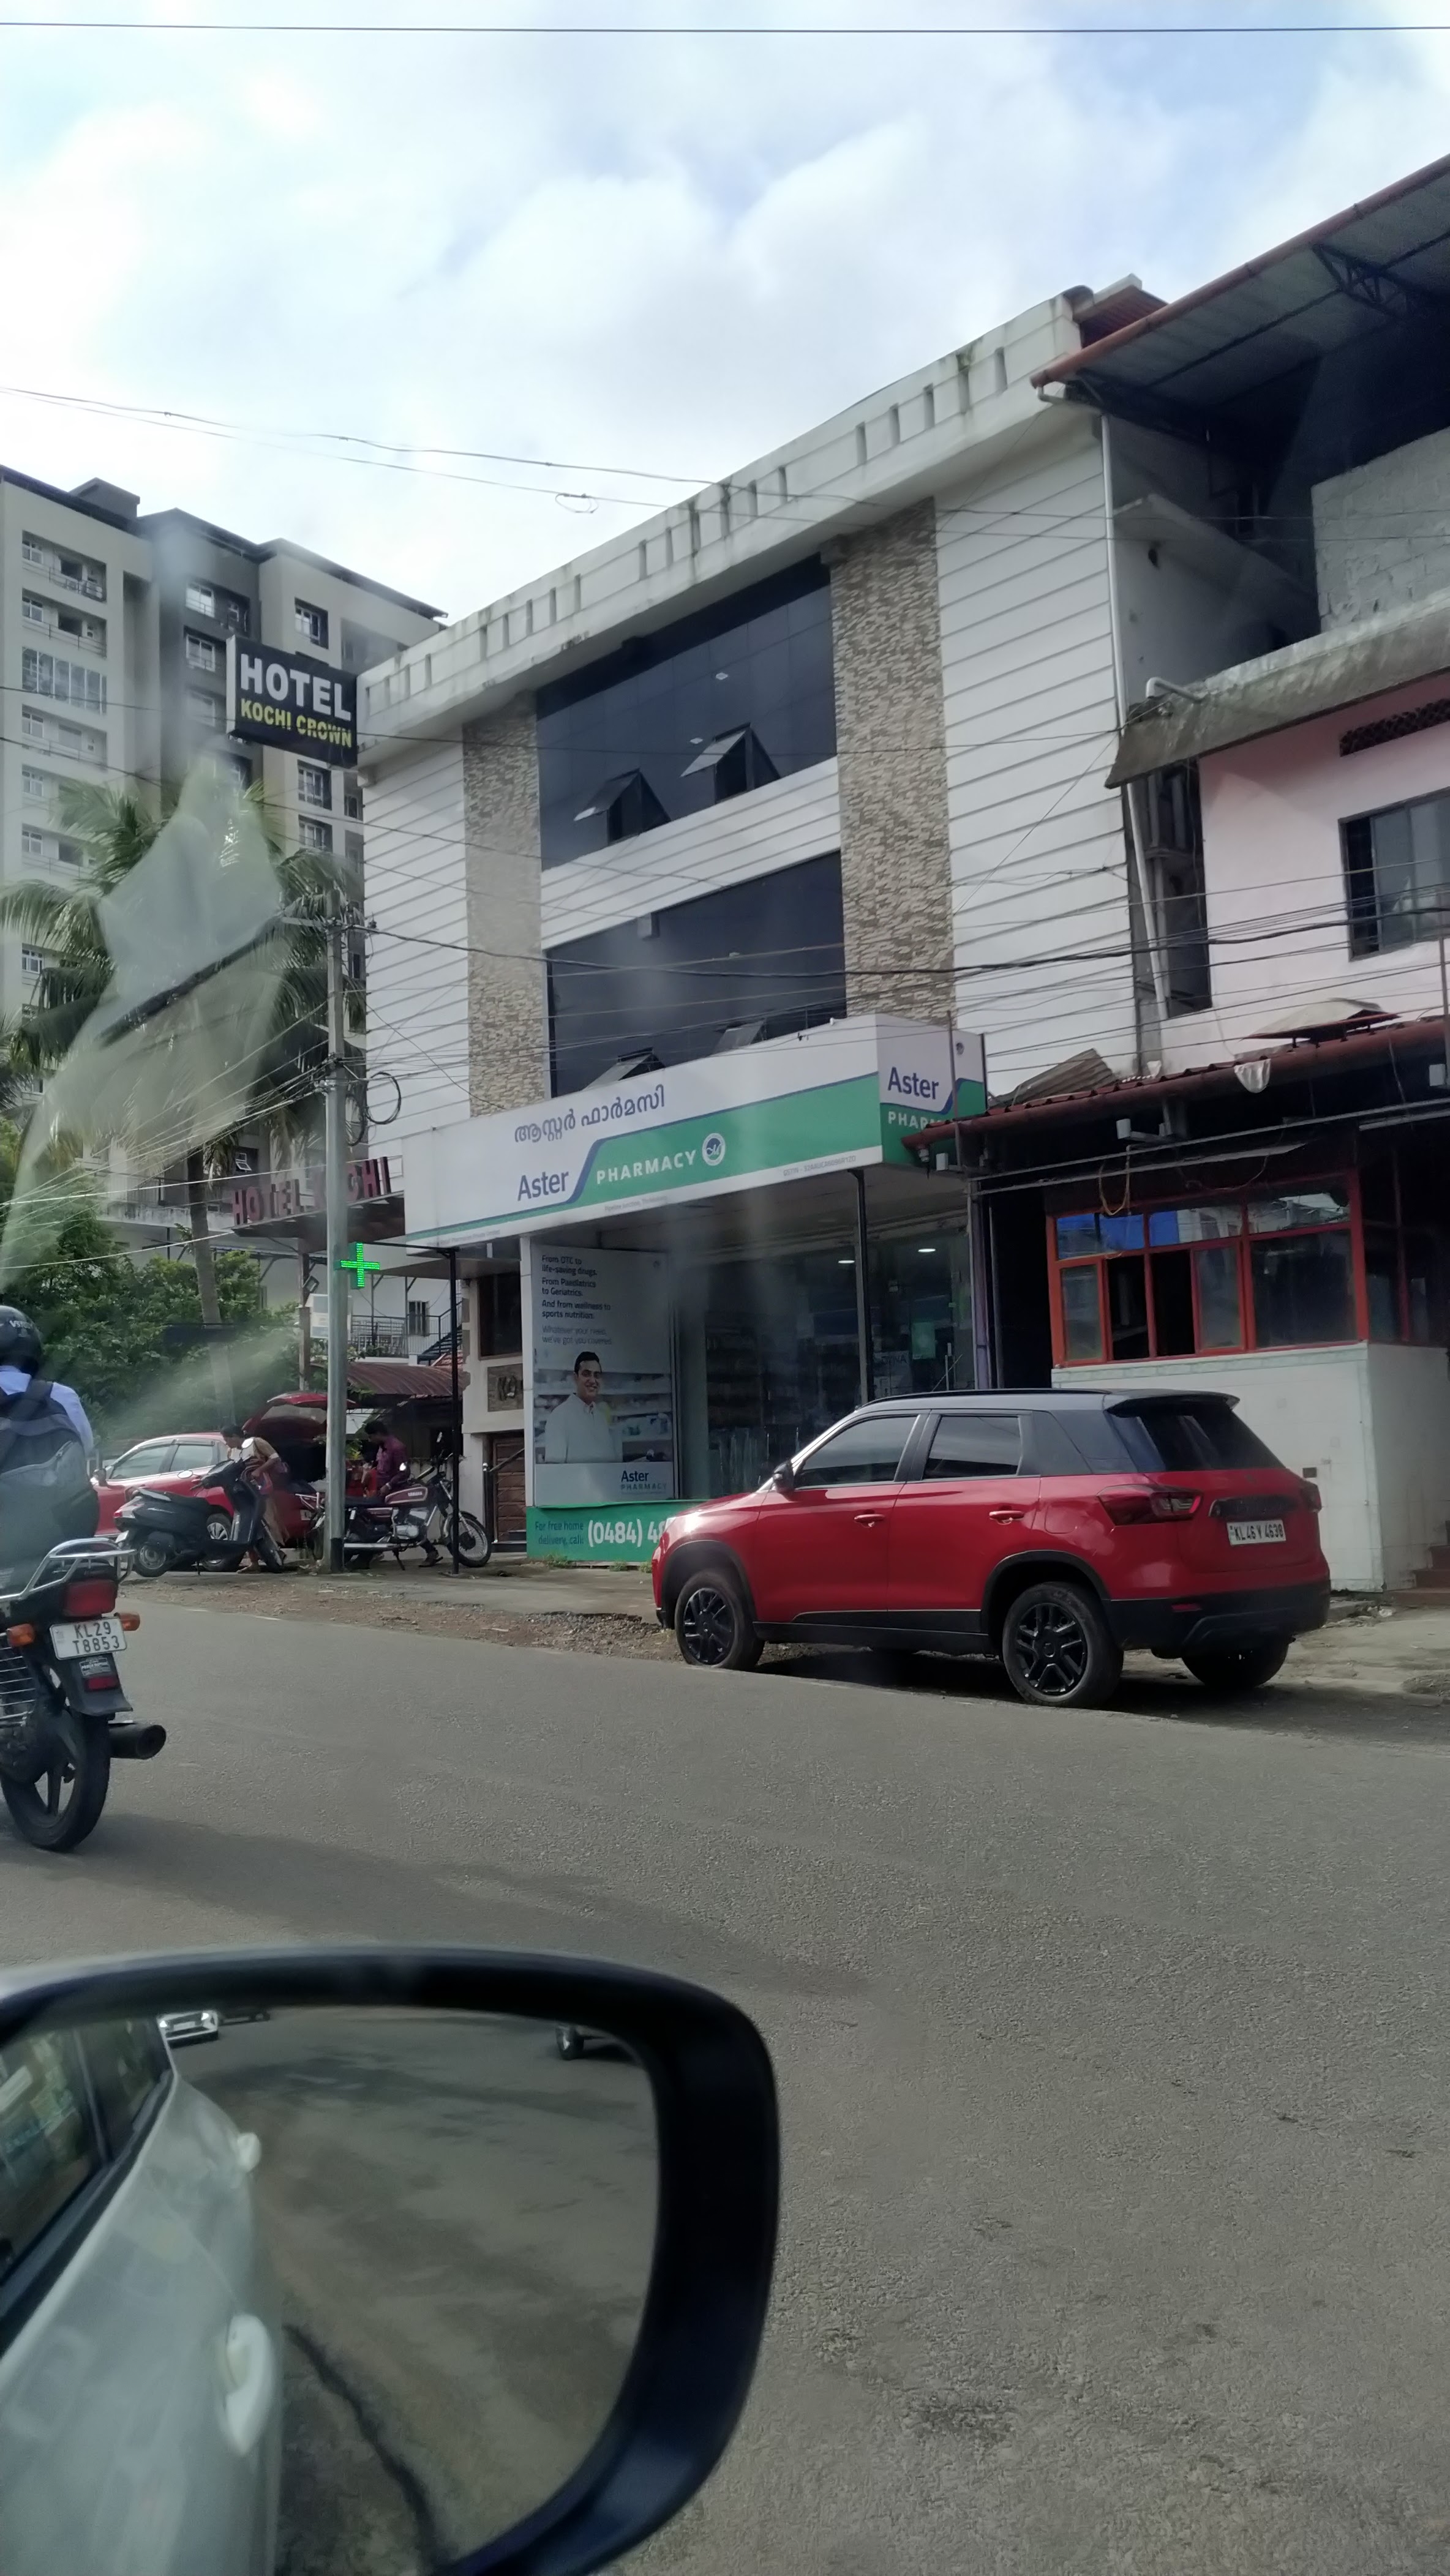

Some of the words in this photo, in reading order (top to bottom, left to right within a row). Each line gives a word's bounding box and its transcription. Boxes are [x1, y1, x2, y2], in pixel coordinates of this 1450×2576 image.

[241, 654, 351, 721] HOTEL
[241, 698, 291, 730] KOCHI
[296, 715, 351, 748] CROWN
[887, 1066, 939, 1099] Aster
[581, 1084, 664, 1126] ഫാർമസി
[517, 1170, 569, 1201] Aster
[596, 1149, 697, 1185] PHARMACY
[233, 1179, 304, 1225] HOTEL
[542, 1265, 576, 1276] life-saving
[542, 1311, 563, 1320] sports
[557, 1300, 573, 1308] from
[574, 1301, 603, 1310] wellness
[621, 1470, 649, 1482] Aster
[535, 1521, 546, 1530] For
[548, 1521, 562, 1530] free
[564, 1521, 584, 1530] home
[588, 1519, 642, 1548] (0484)
[1234, 1526, 1246, 1541] KL
[73, 1622, 111, 1639] KL29
